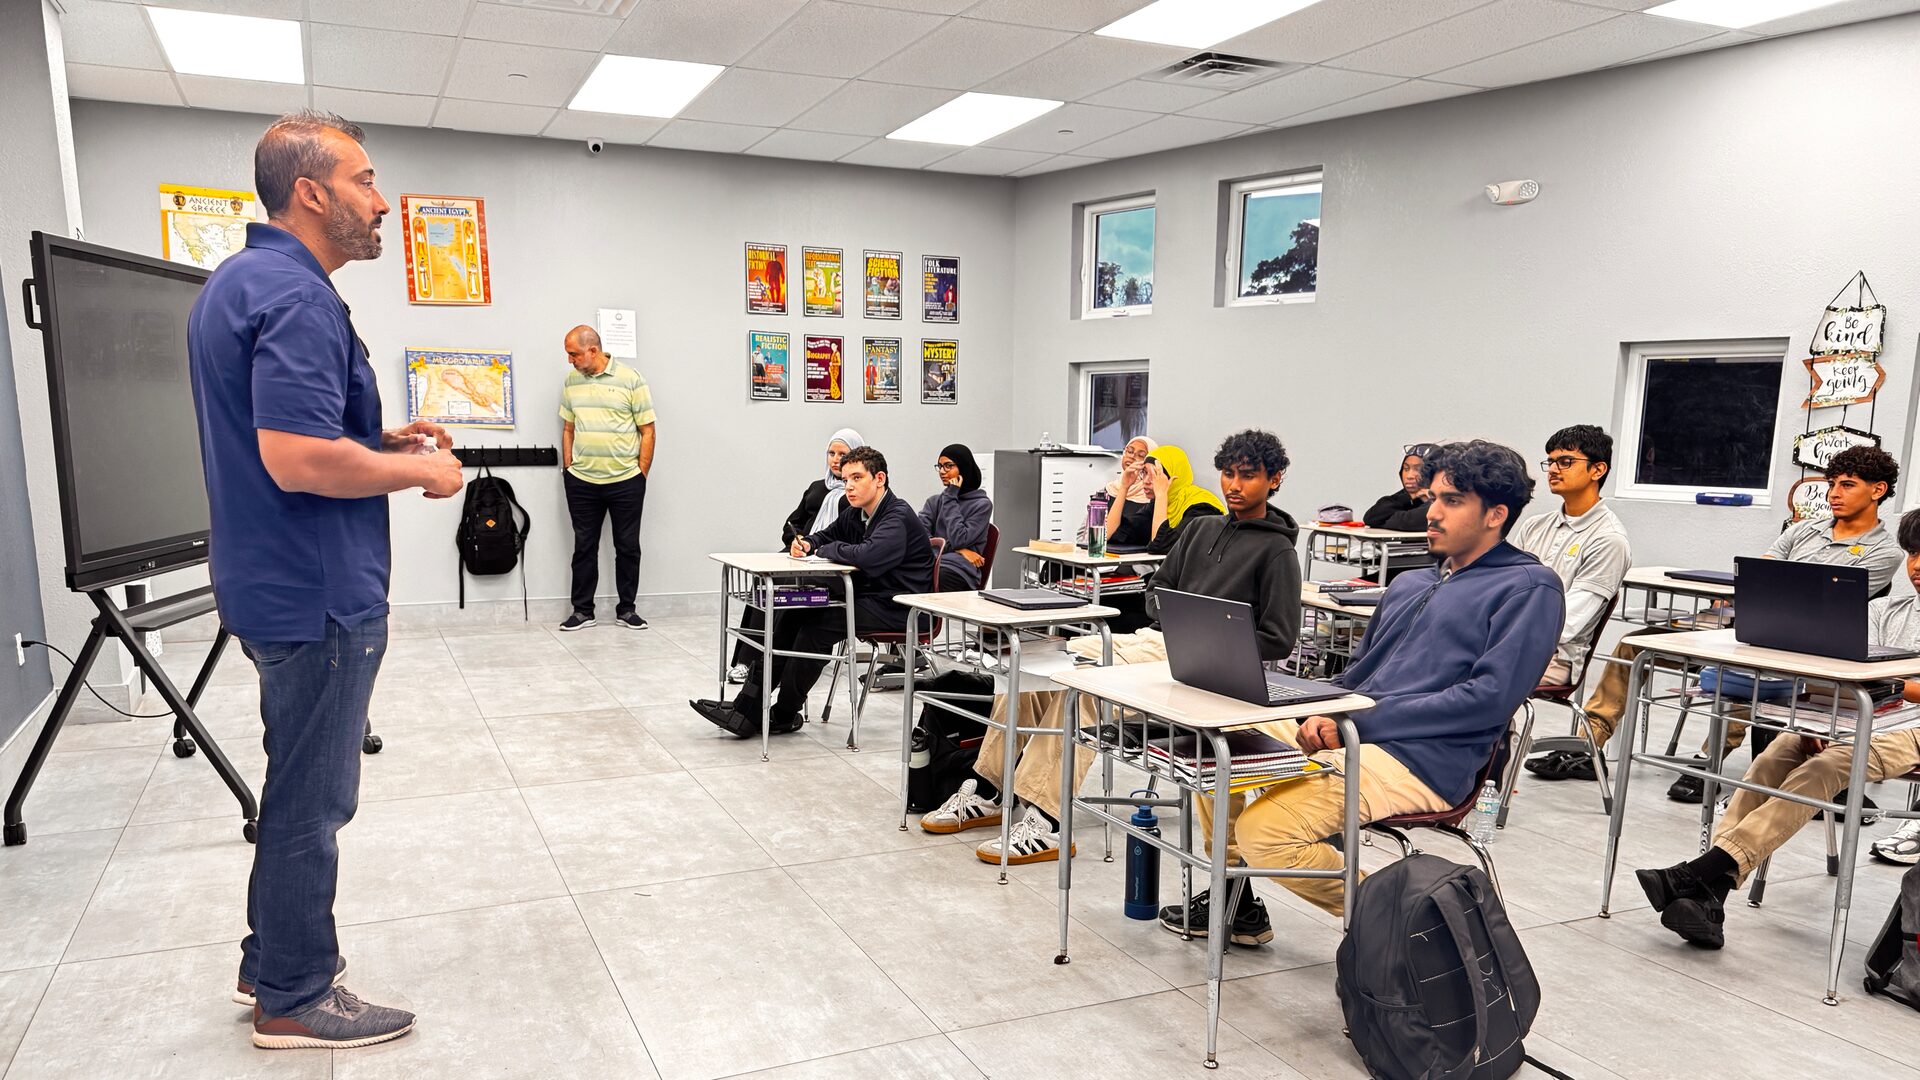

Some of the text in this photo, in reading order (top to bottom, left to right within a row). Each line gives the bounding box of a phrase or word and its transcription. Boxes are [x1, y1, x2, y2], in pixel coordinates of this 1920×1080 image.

[189, 197, 228, 207] ANCIENT
[191, 205, 226, 214] GREECE
[422, 207, 466, 216] ANCIENT EGYPT
[867, 258, 898, 268] SCIENCE
[867, 267, 899, 278] FICTION
[925, 266, 957, 274] LITERATURE
[1845, 316, 1859, 329] Be
[1824, 321, 1873, 346] kind
[755, 335, 787, 343] REALISTIC
[761, 342, 787, 350] FICTION
[924, 347, 956, 359] MYSTERY
[432, 357, 486, 365] MESOPOTAMIA
[1823, 375, 1871, 396] going
[1804, 484, 1825, 500] Be
